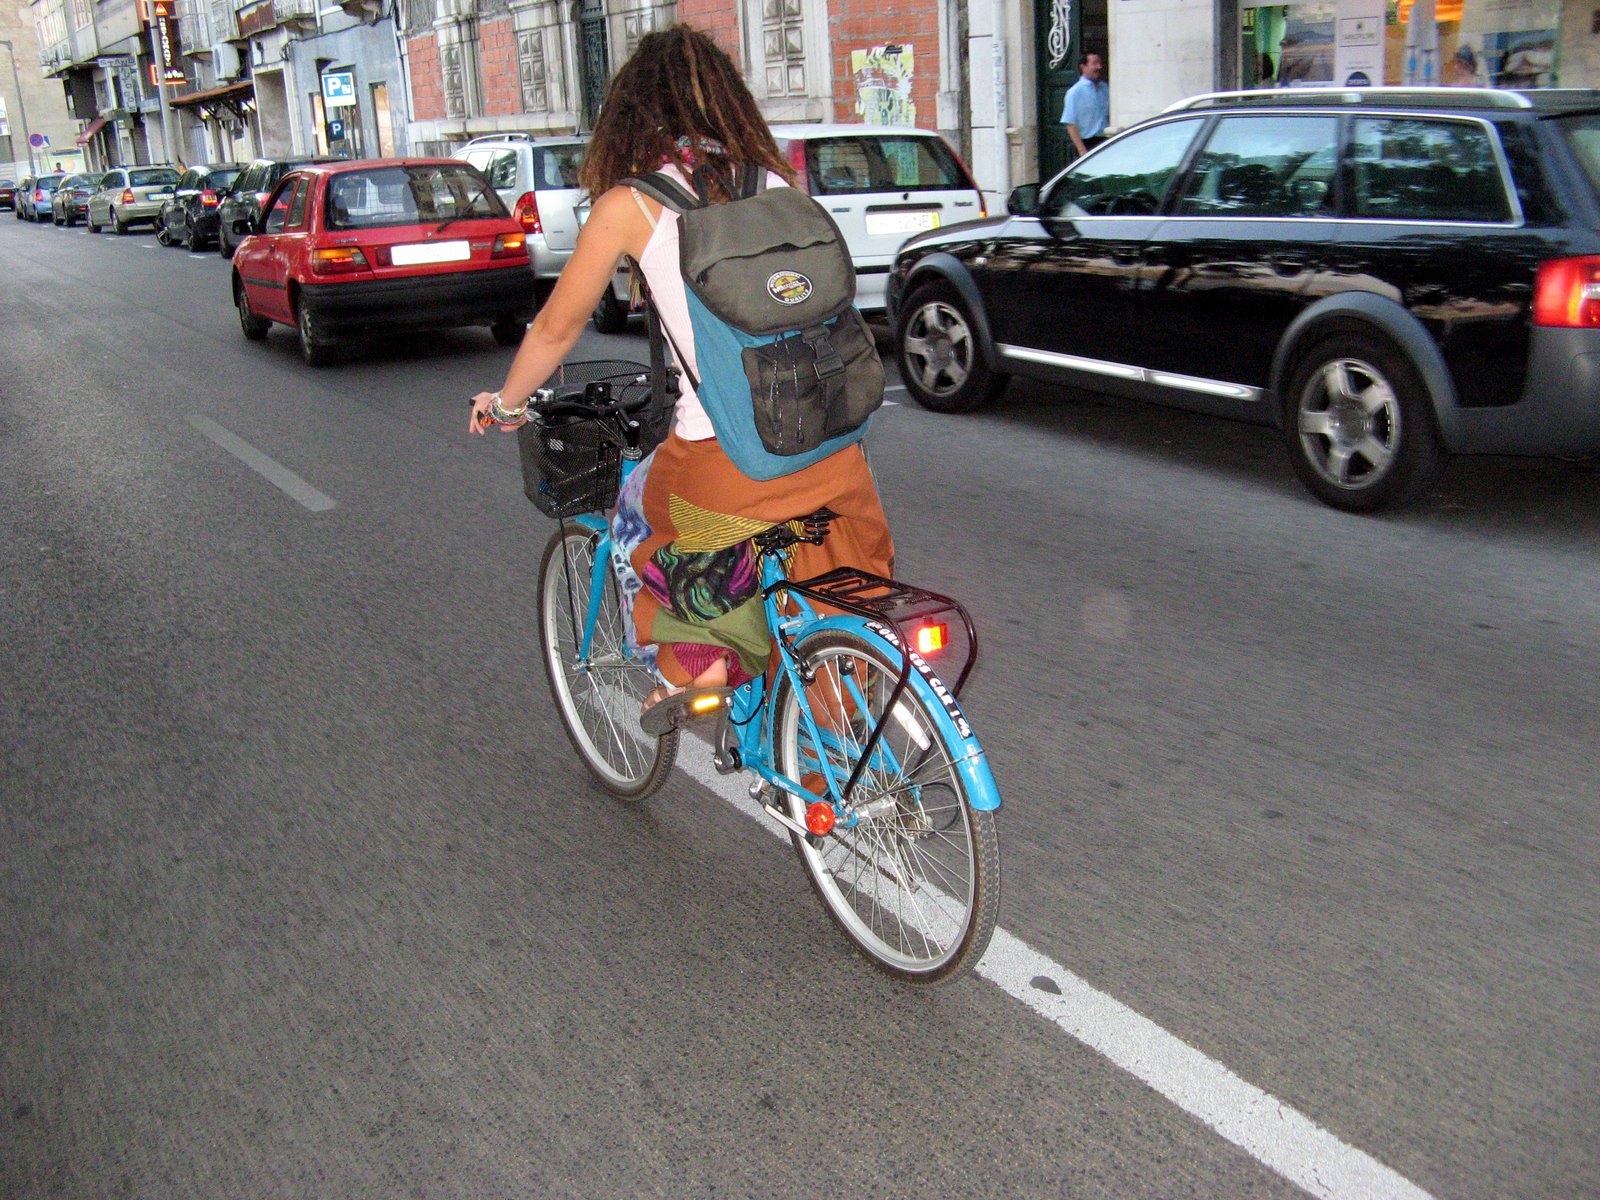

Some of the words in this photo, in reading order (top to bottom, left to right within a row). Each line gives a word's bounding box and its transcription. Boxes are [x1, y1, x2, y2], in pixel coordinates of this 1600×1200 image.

[327, 77, 341, 95] P
[332, 123, 342, 135] P
[907, 647, 931, 674] ESS
[929, 678, 953, 706] CAR
